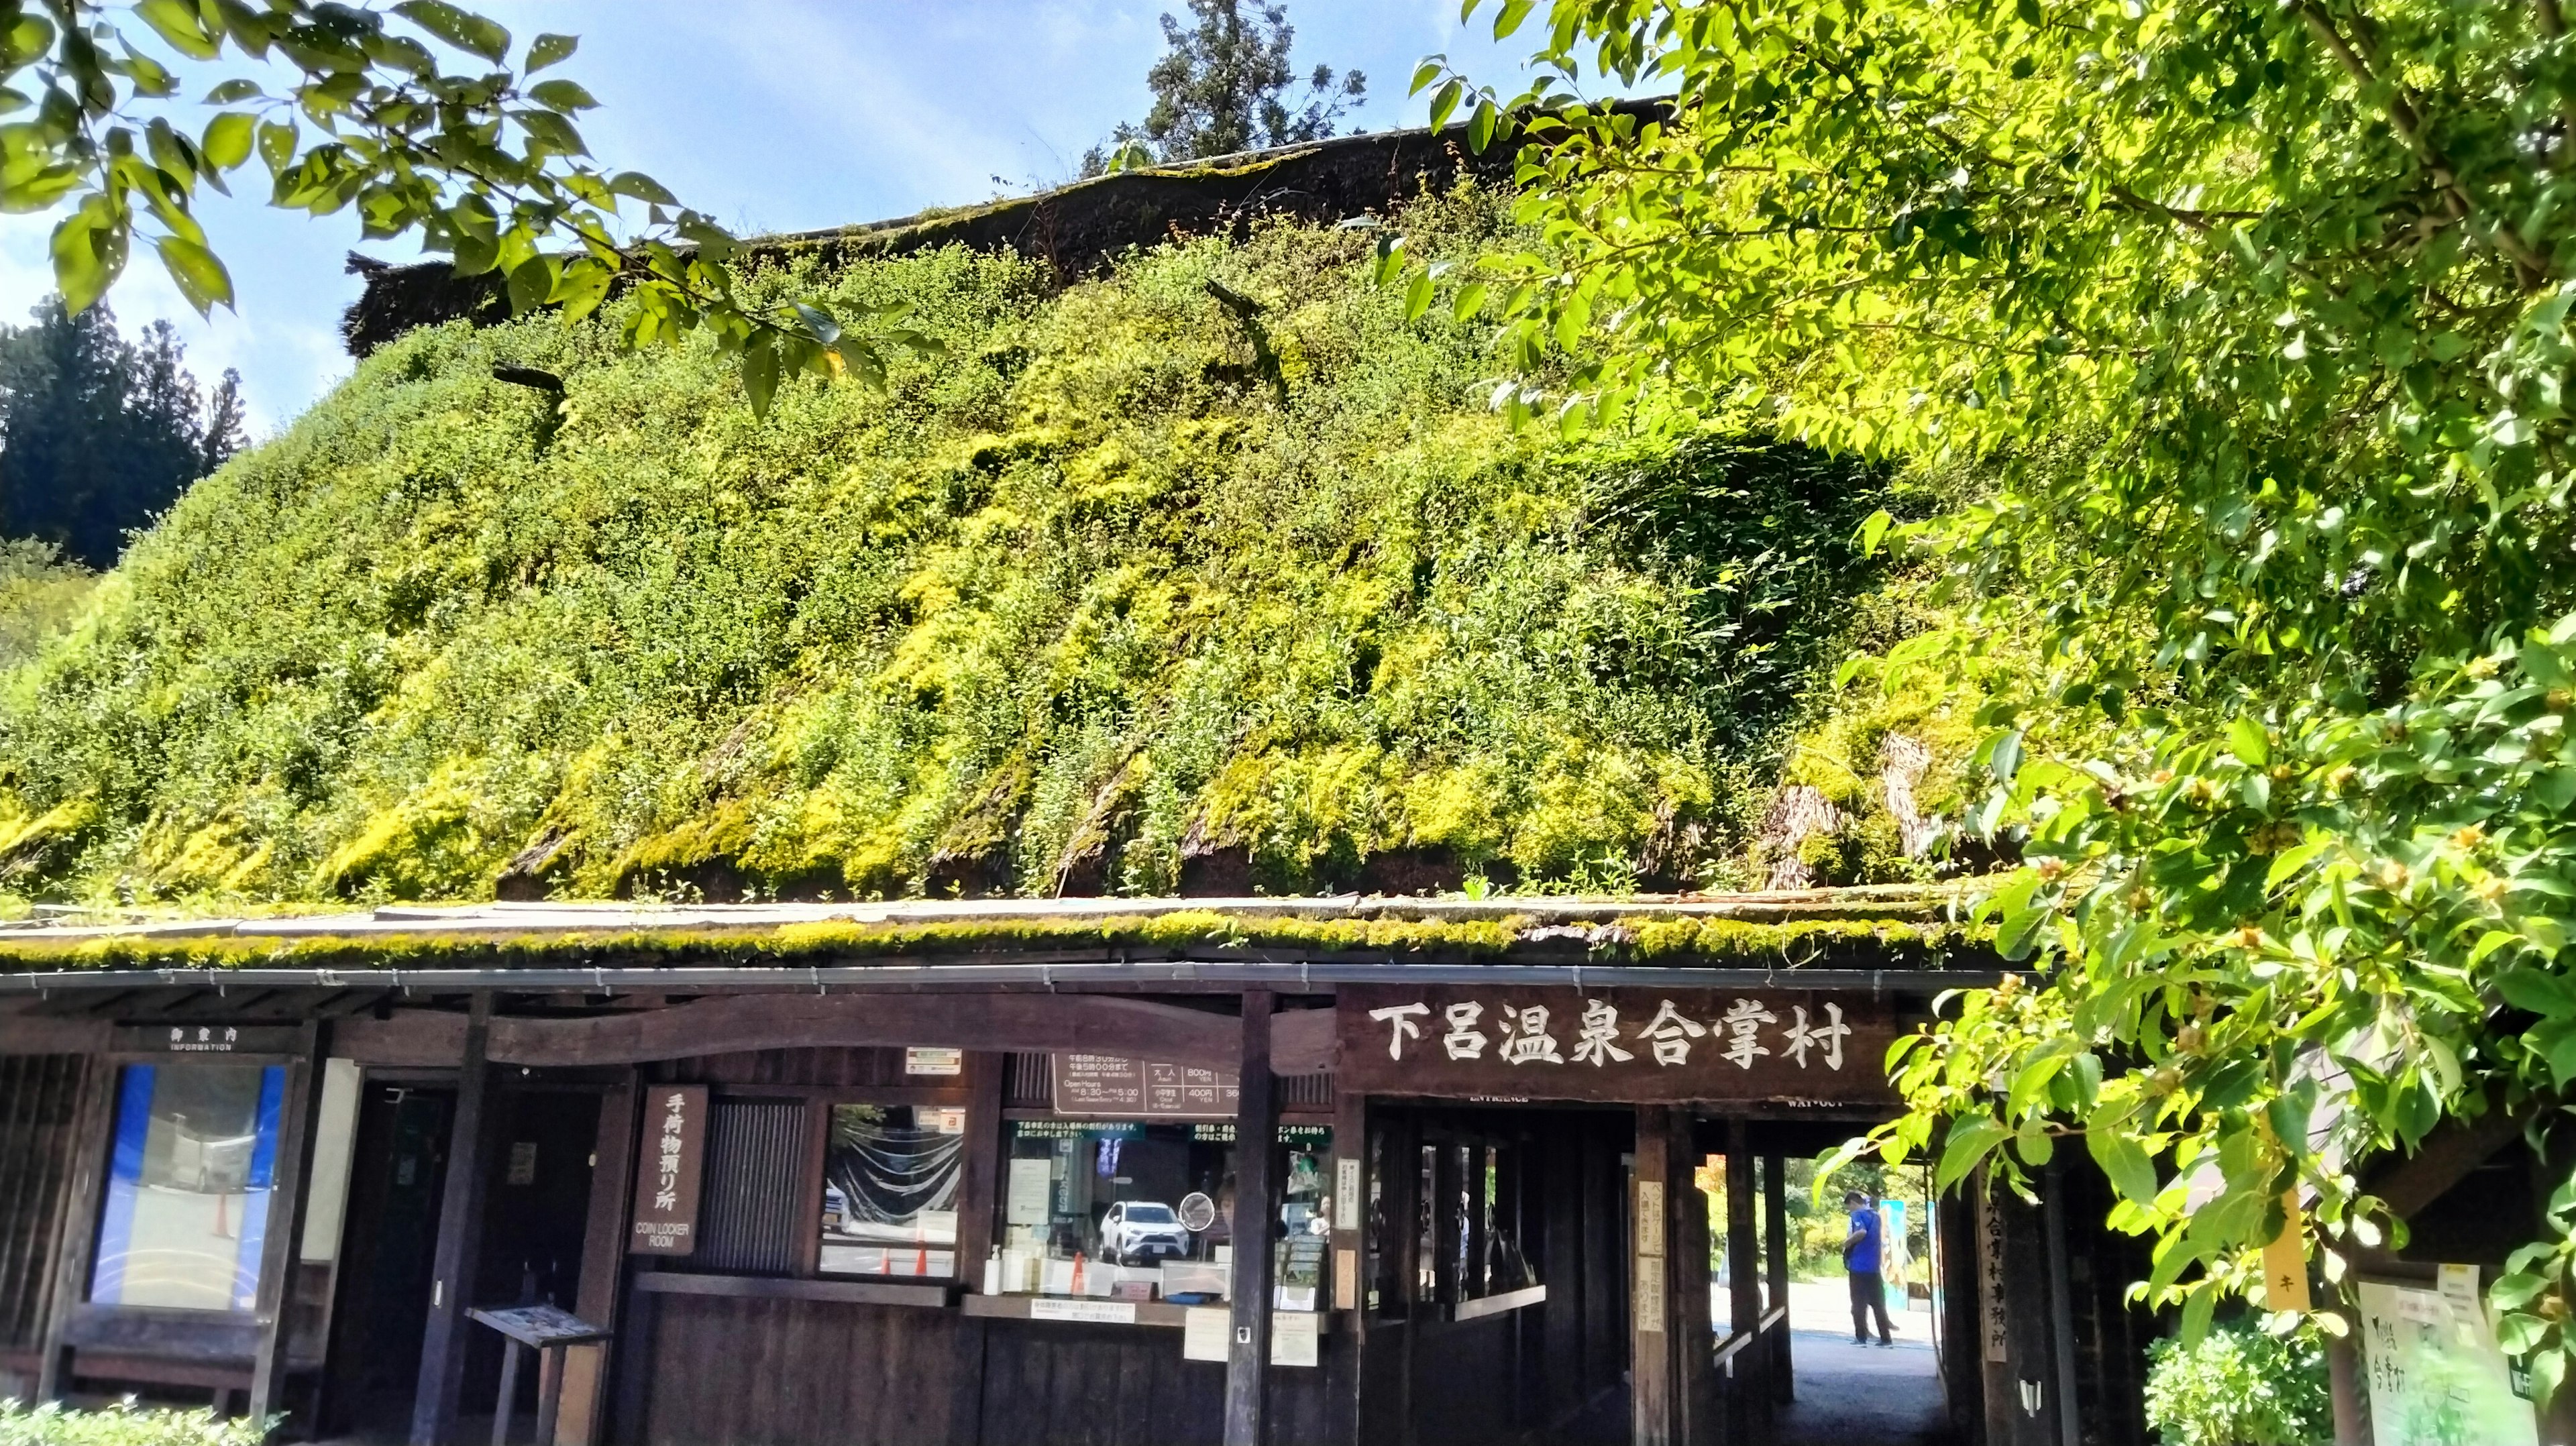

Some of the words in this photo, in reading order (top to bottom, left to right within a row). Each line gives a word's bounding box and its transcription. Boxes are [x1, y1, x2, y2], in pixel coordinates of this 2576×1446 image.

[170, 1025, 237, 1042] 御案内
[1368, 999, 1851, 1071] 下呂温泉合掌村
[170, 1044, 231, 1052] INFORMATION
[1064, 1079, 1081, 1088] Open
[1188, 1089, 1213, 1097] 400円
[655, 1093, 686, 1211] 手荷物預り所
[635, 1222, 657, 1235] COIN
[658, 1223, 690, 1235] LOCKER
[649, 1235, 674, 1247] ROOM
